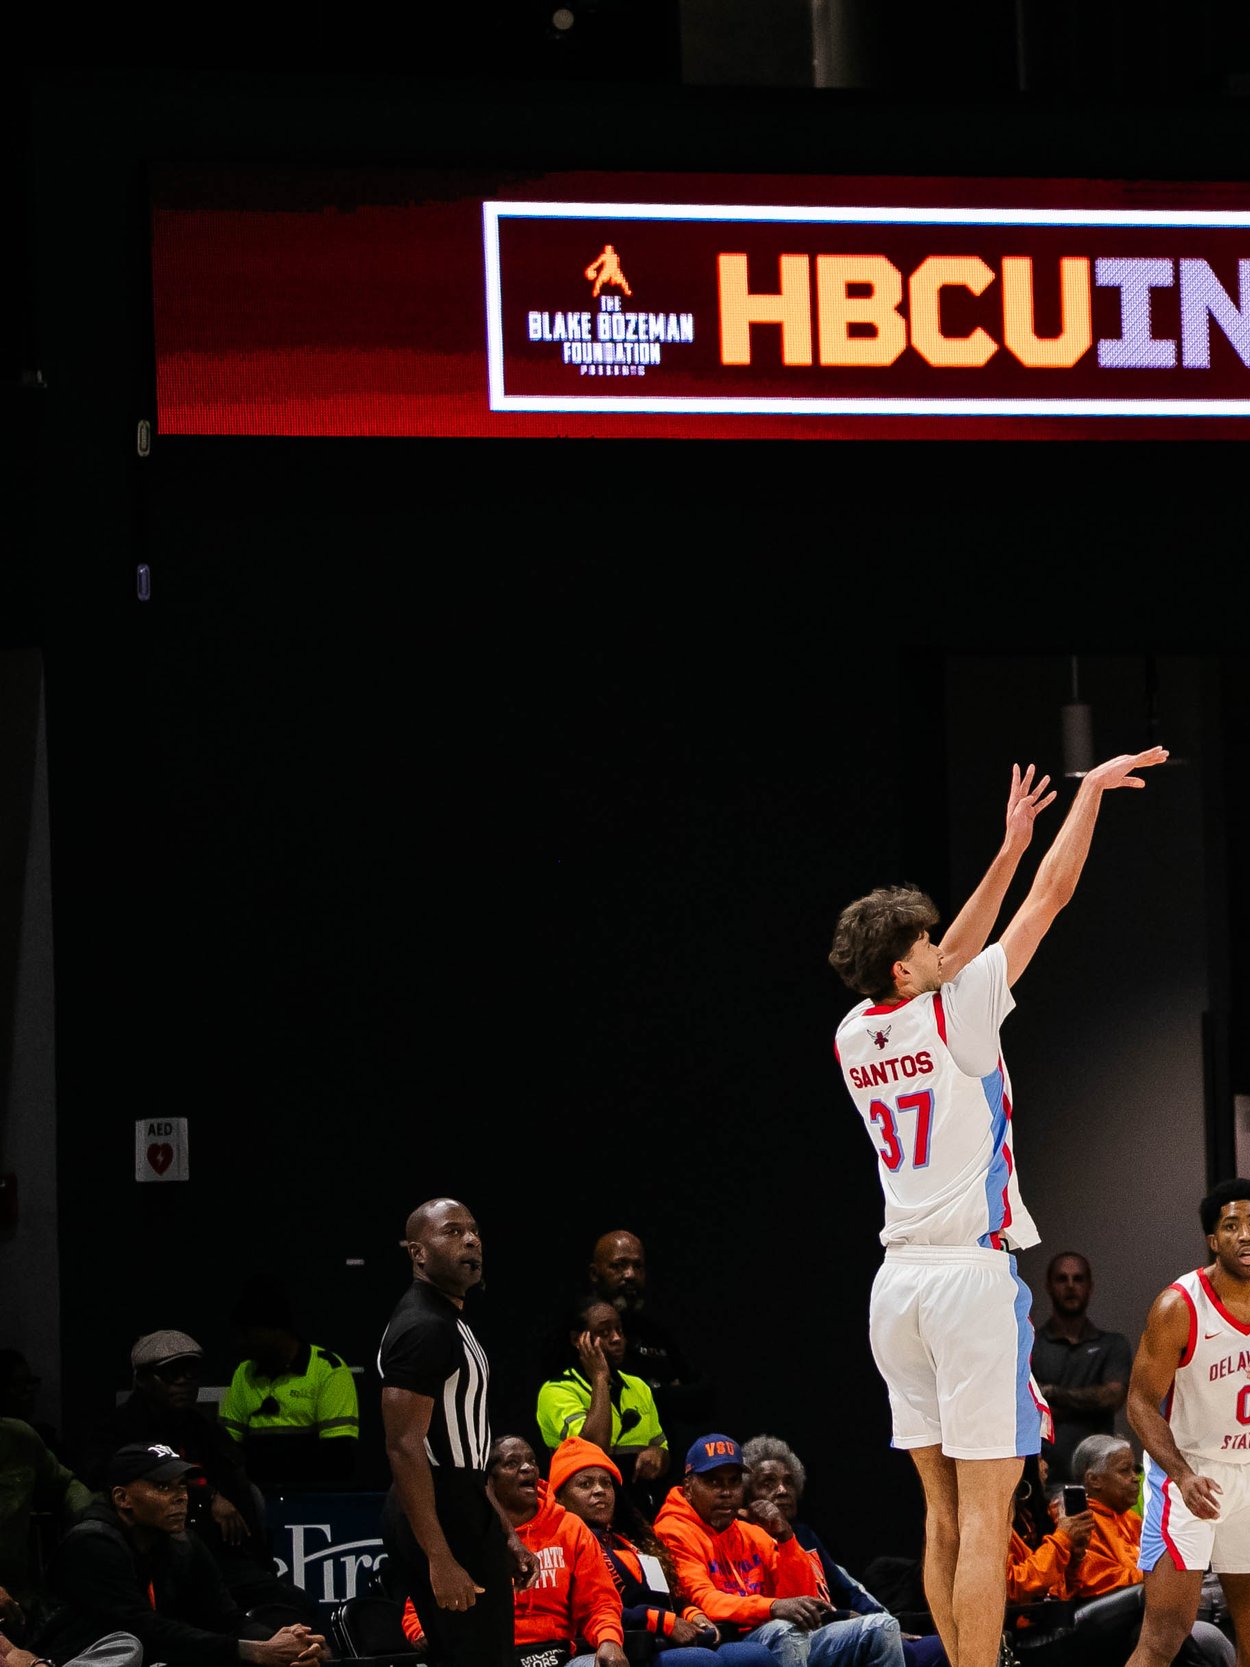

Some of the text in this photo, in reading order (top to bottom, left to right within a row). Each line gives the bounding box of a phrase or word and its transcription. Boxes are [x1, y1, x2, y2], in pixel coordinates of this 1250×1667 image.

[600, 295, 622, 312] THE
[528, 311, 694, 342] BLAKE BOZEMAN
[563, 342, 662, 364] FOUNDATION
[849, 1050, 934, 1089] SANTOS
[147, 1122, 173, 1137] AED
[870, 1088, 935, 1173] 37
[704, 1440, 735, 1458] VSU
